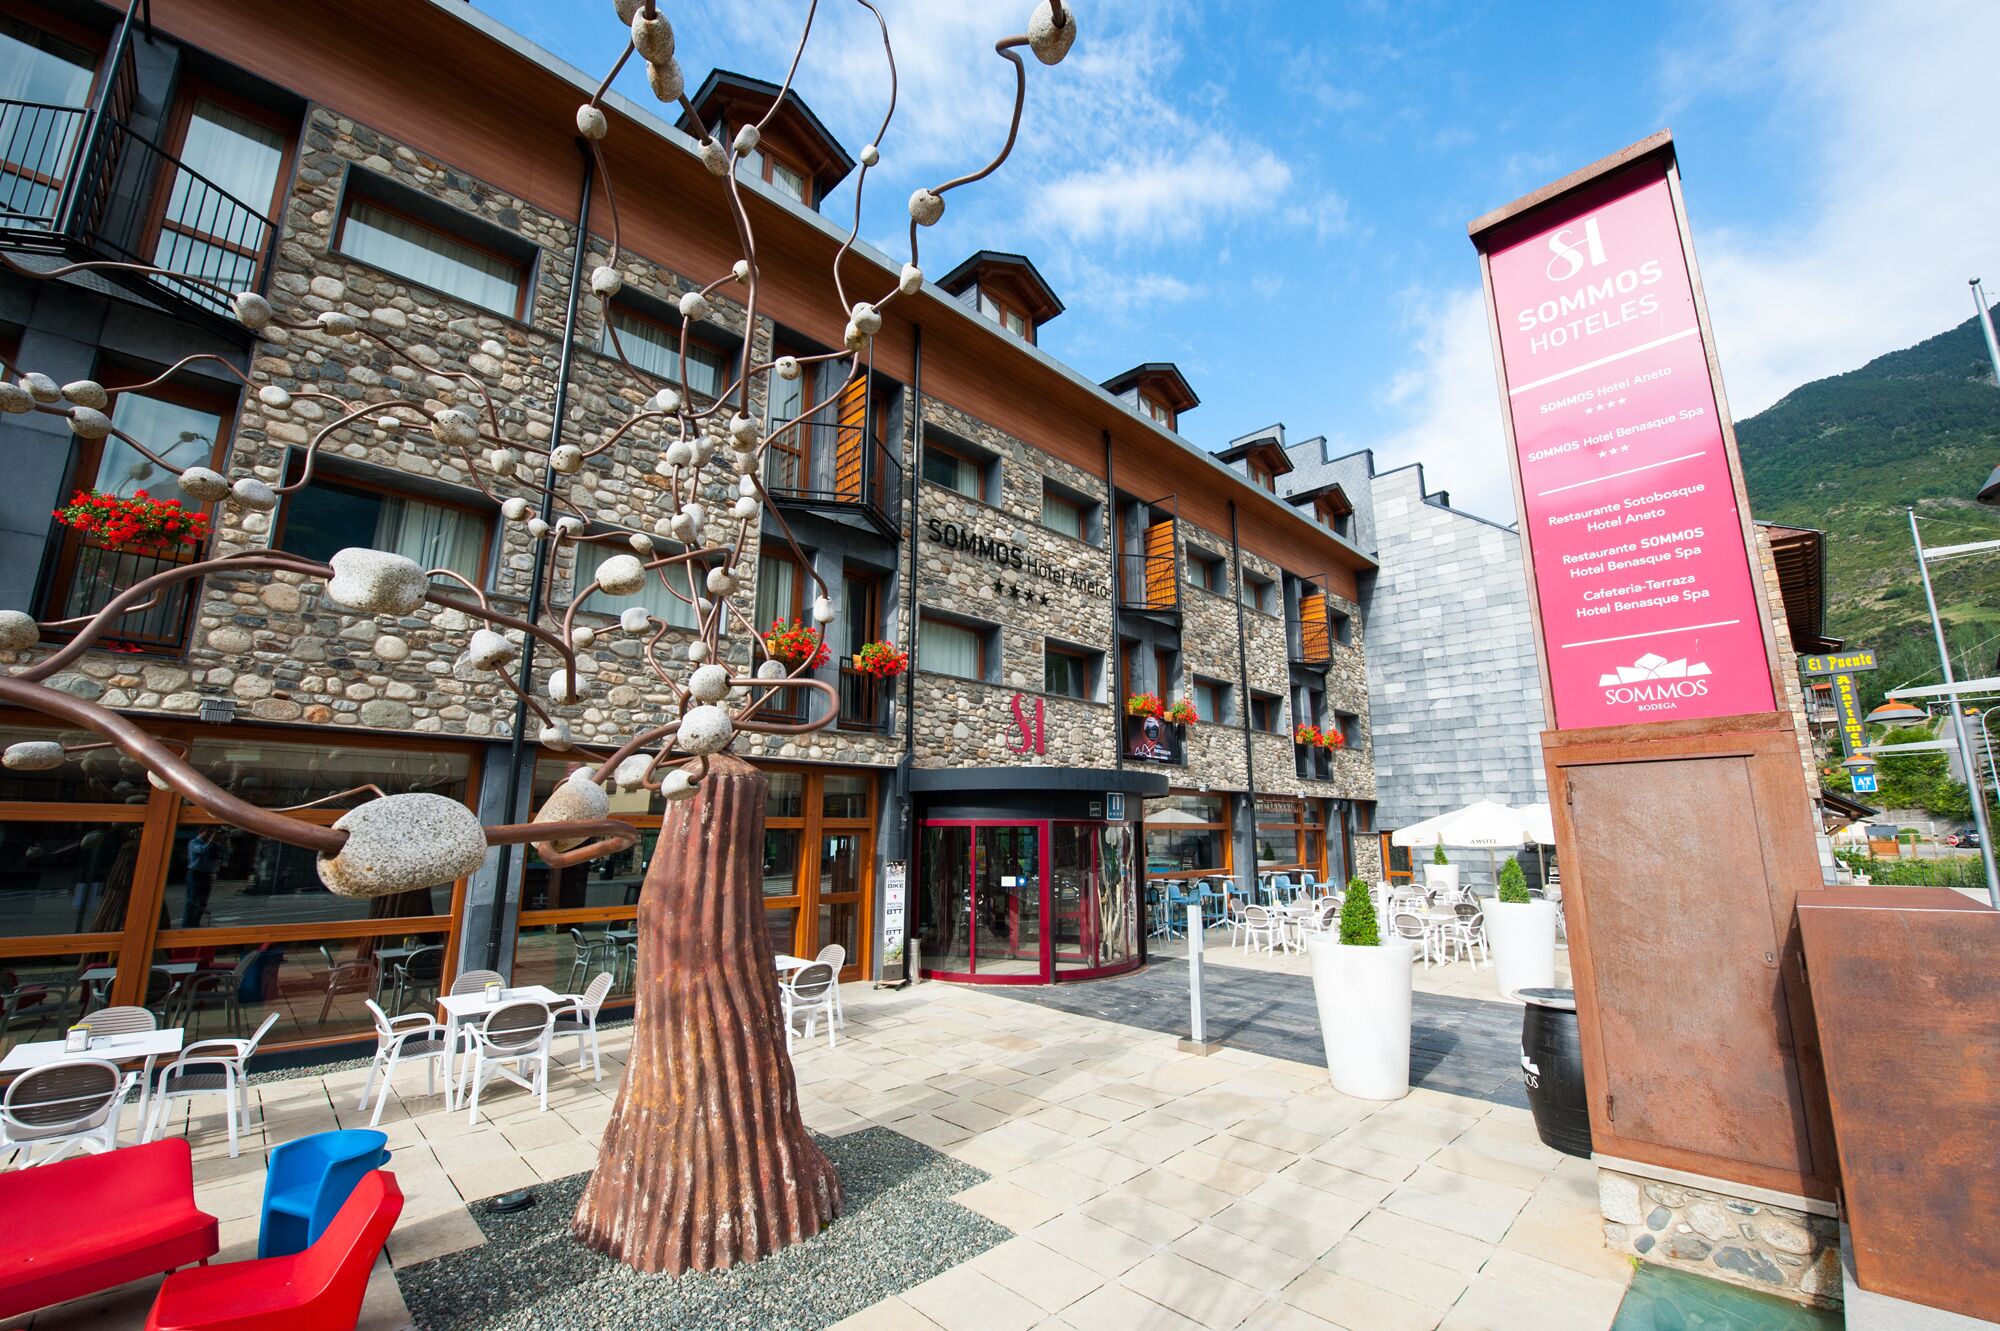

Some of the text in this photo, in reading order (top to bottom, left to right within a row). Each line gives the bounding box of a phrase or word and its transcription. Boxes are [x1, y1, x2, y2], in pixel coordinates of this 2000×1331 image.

[1517, 259, 1663, 331] SOMMOS
[1530, 293, 1659, 354] HOTELES
[1540, 367, 1672, 414] SOMMOS Hotel Aneto
[1527, 406, 1705, 462] SOMMOS Hotel Benasque Spa
[1549, 483, 1705, 526] Restaurante Sotobosque
[1587, 508, 1666, 532] Hotel Aneto
[928, 518, 1108, 599] SOMMOS Hotel Aneto
[1562, 527, 1704, 565] Restaurante SOMMOS
[1570, 546, 1702, 579] Hotel Benasque Spa
[1576, 588, 1710, 618] Hotel Benasque Spa
[1807, 653, 1873, 671] El Puente
[1606, 679, 1708, 705] SOMMOS
[1638, 702, 1677, 712] BODEGA
